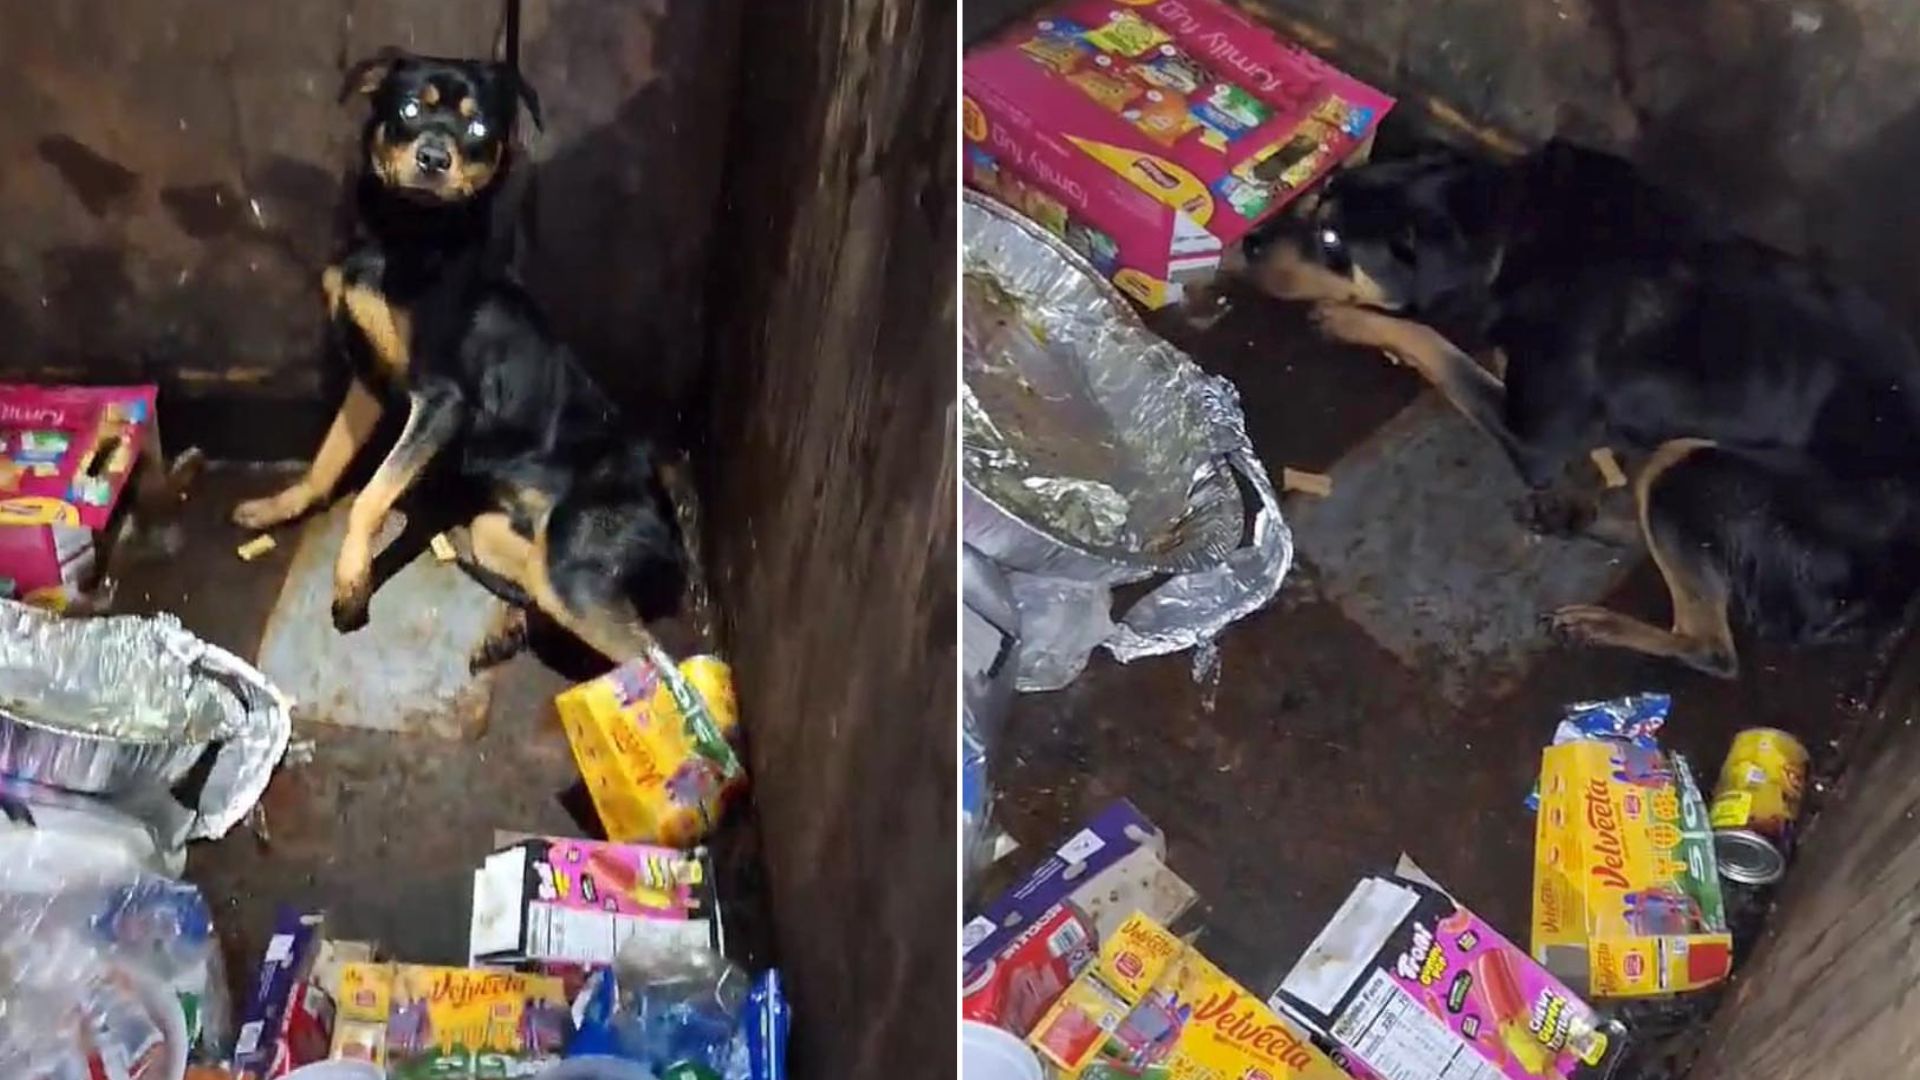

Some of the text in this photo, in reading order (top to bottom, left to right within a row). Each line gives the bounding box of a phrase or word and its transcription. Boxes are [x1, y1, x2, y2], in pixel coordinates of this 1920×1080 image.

[1028, 146, 1090, 209] family
[1584, 777, 1631, 890] Velveeta
[1193, 989, 1314, 1072] Velveeta
